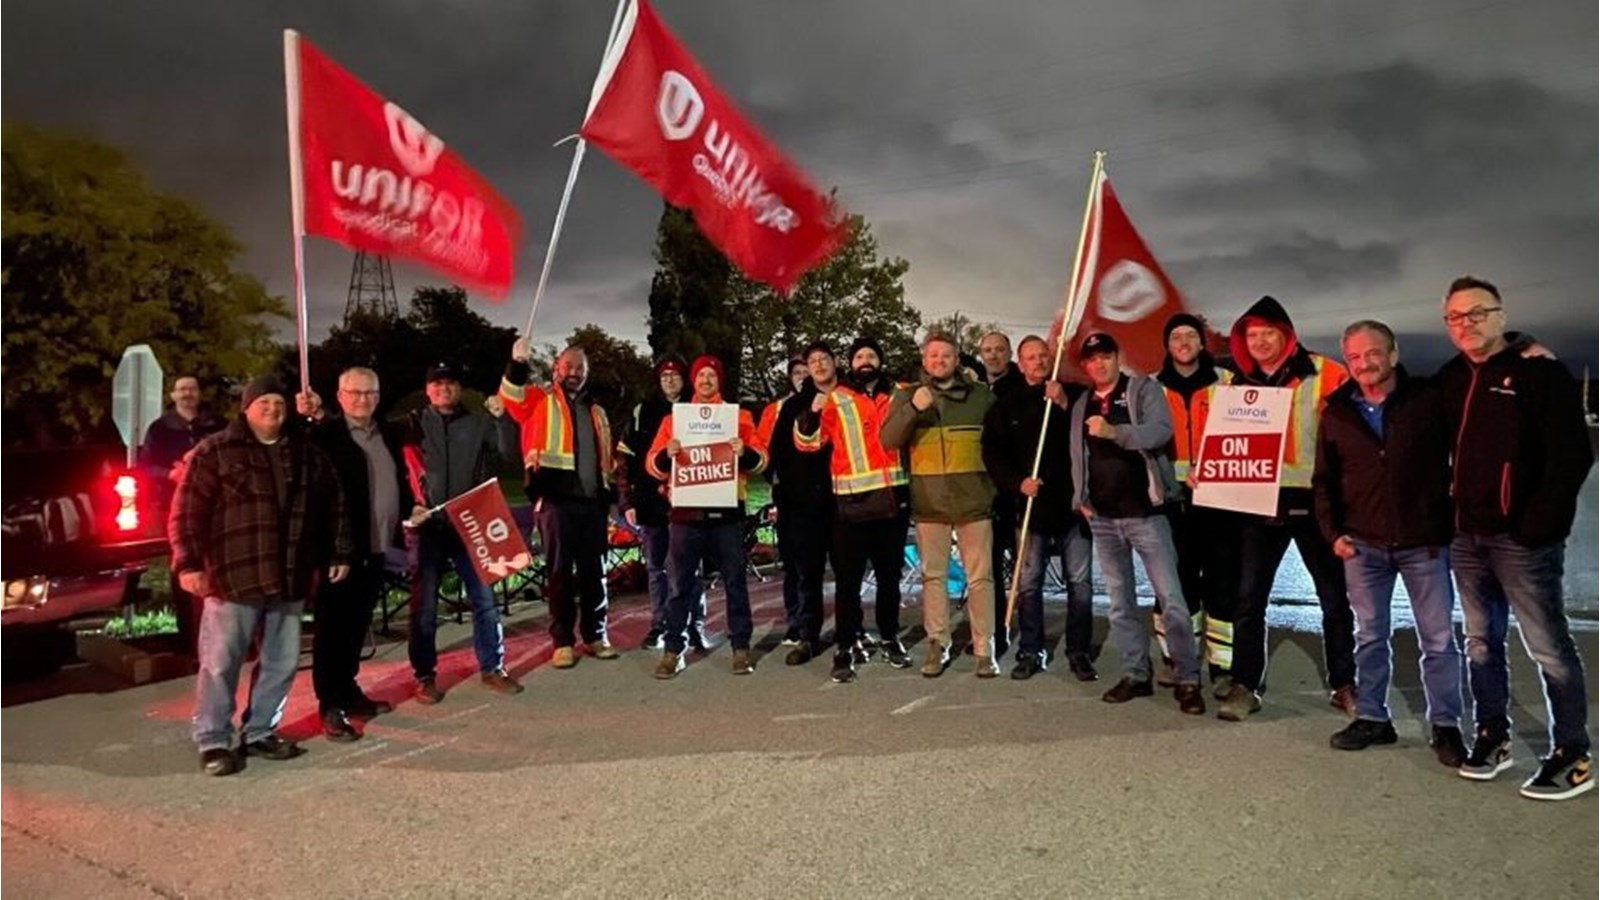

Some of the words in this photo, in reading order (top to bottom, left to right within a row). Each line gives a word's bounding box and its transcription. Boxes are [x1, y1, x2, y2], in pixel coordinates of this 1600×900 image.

[1228, 407, 1267, 417] UNIFOR
[688, 422, 722, 430] UNIFOR
[690, 447, 711, 463] ON
[1221, 438, 1248, 456] ON
[678, 463, 732, 483] STRIKE
[1203, 460, 1273, 478] STRIKE
